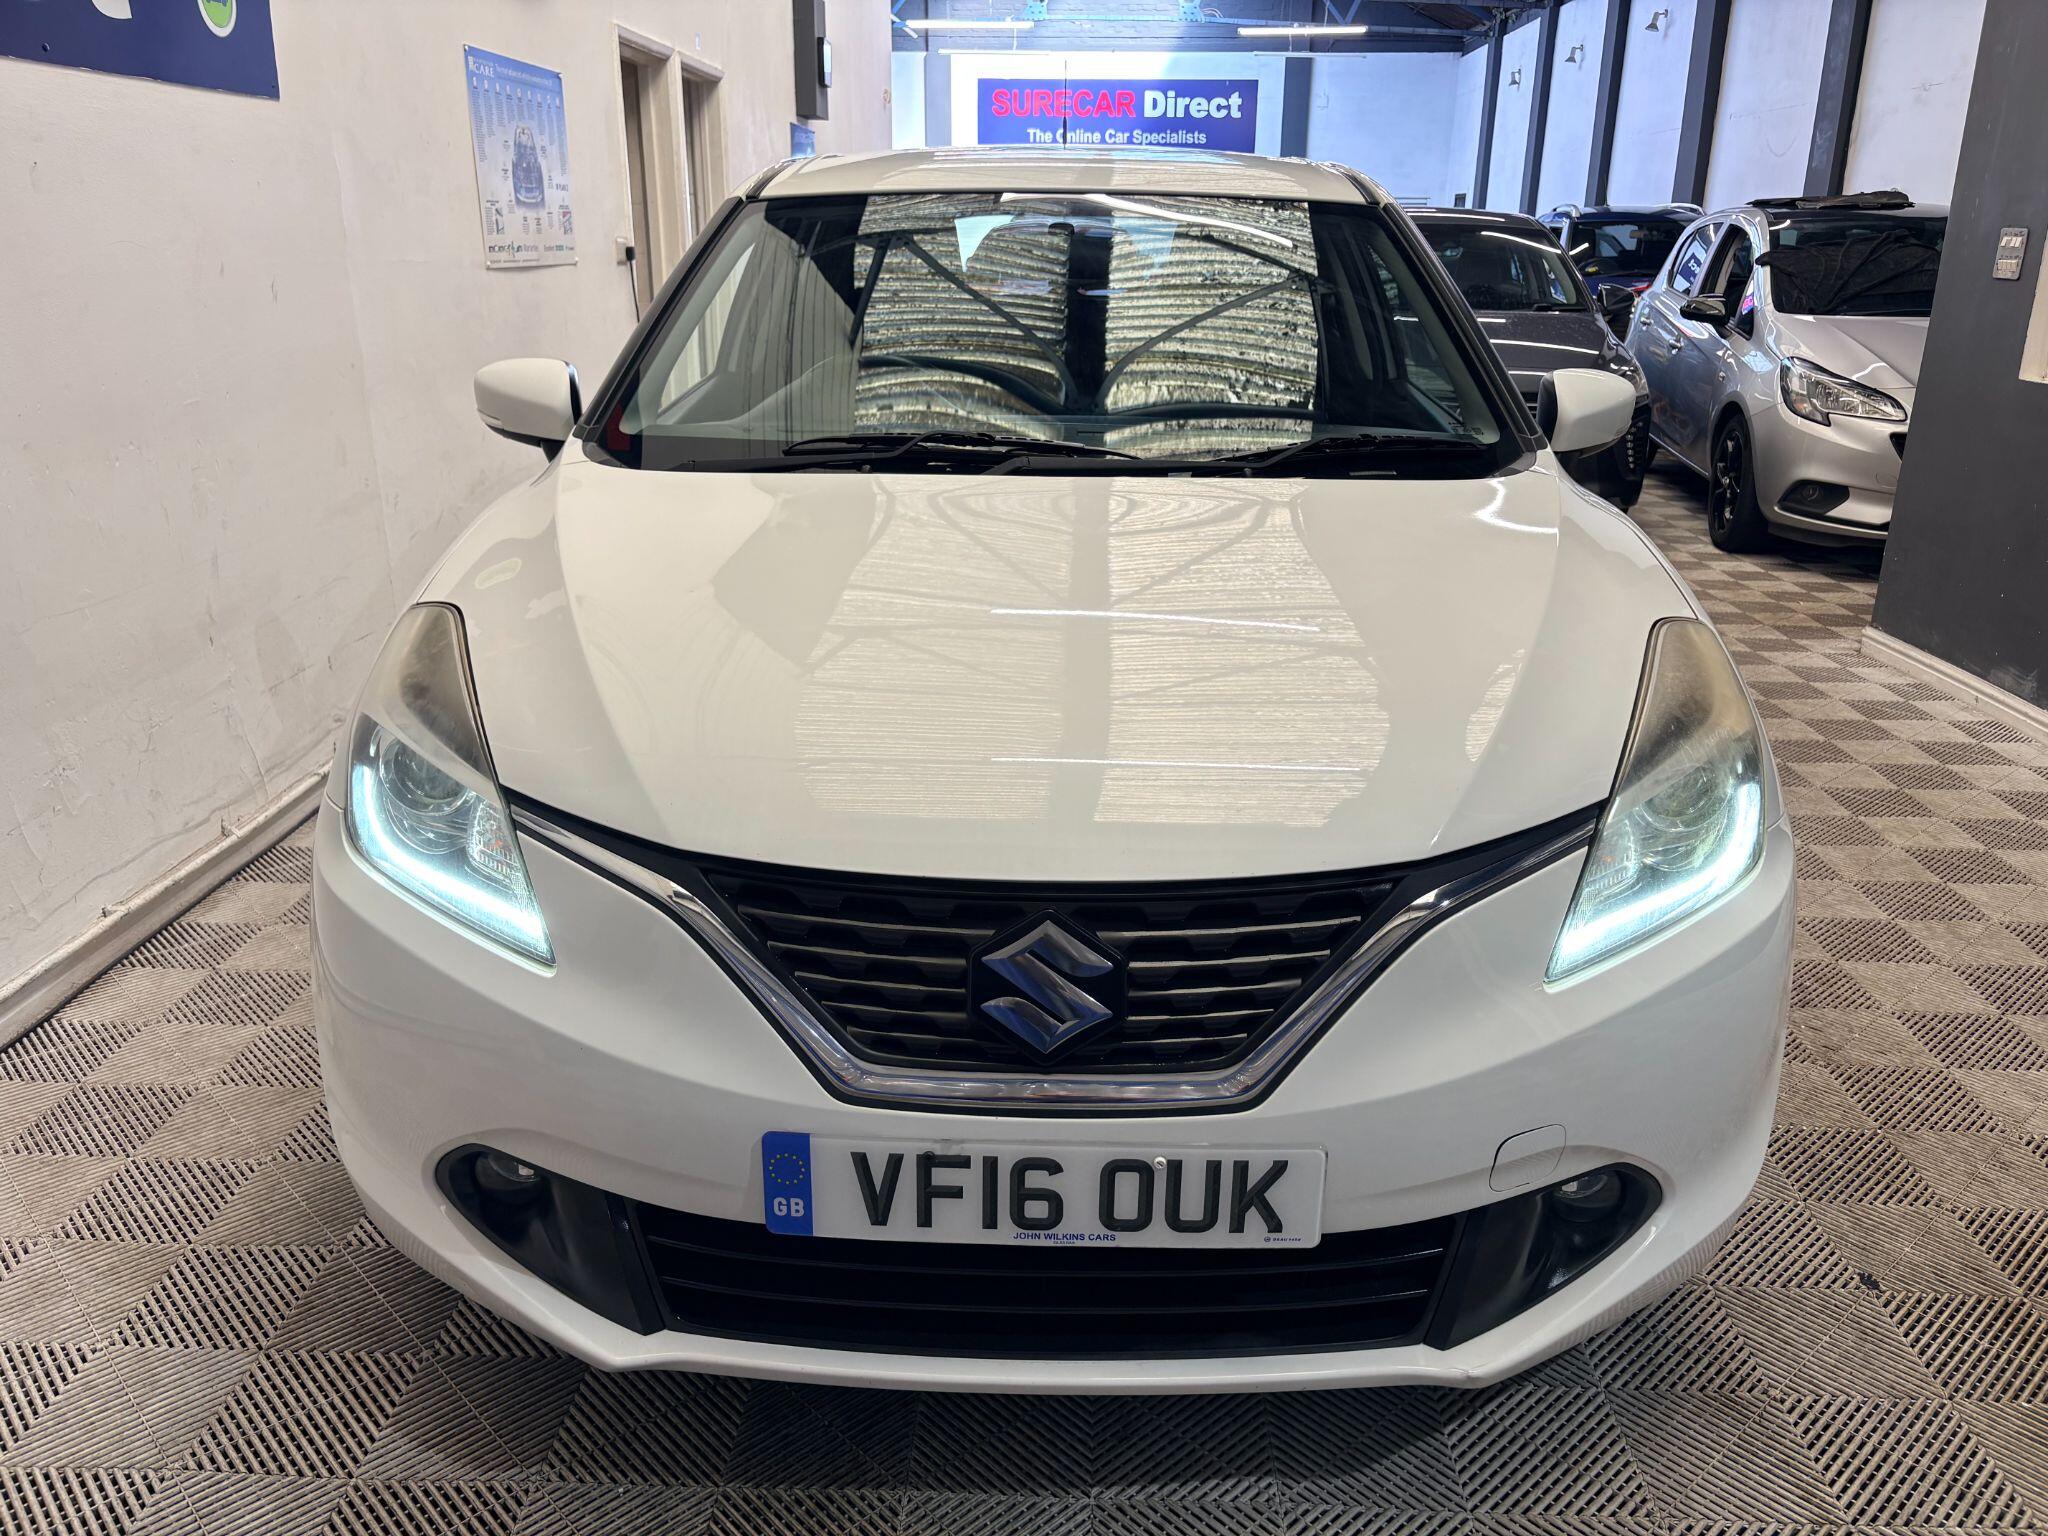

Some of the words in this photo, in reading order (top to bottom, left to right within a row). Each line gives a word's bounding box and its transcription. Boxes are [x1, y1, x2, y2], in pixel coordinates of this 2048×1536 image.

[992, 89, 1136, 118] SURECAR
[1144, 90, 1242, 119] Direct
[1027, 128, 1053, 143] The
[1105, 128, 1130, 143] Car
[1132, 129, 1207, 145] Specialists
[850, 1151, 1065, 1231] VF16
[1099, 1158, 1289, 1233] OUK
[773, 1197, 805, 1217] GB
[1013, 1232, 1041, 1240] JOHN
[1044, 1232, 1086, 1241] WILKINS
[1088, 1233, 1116, 1241] CARS
